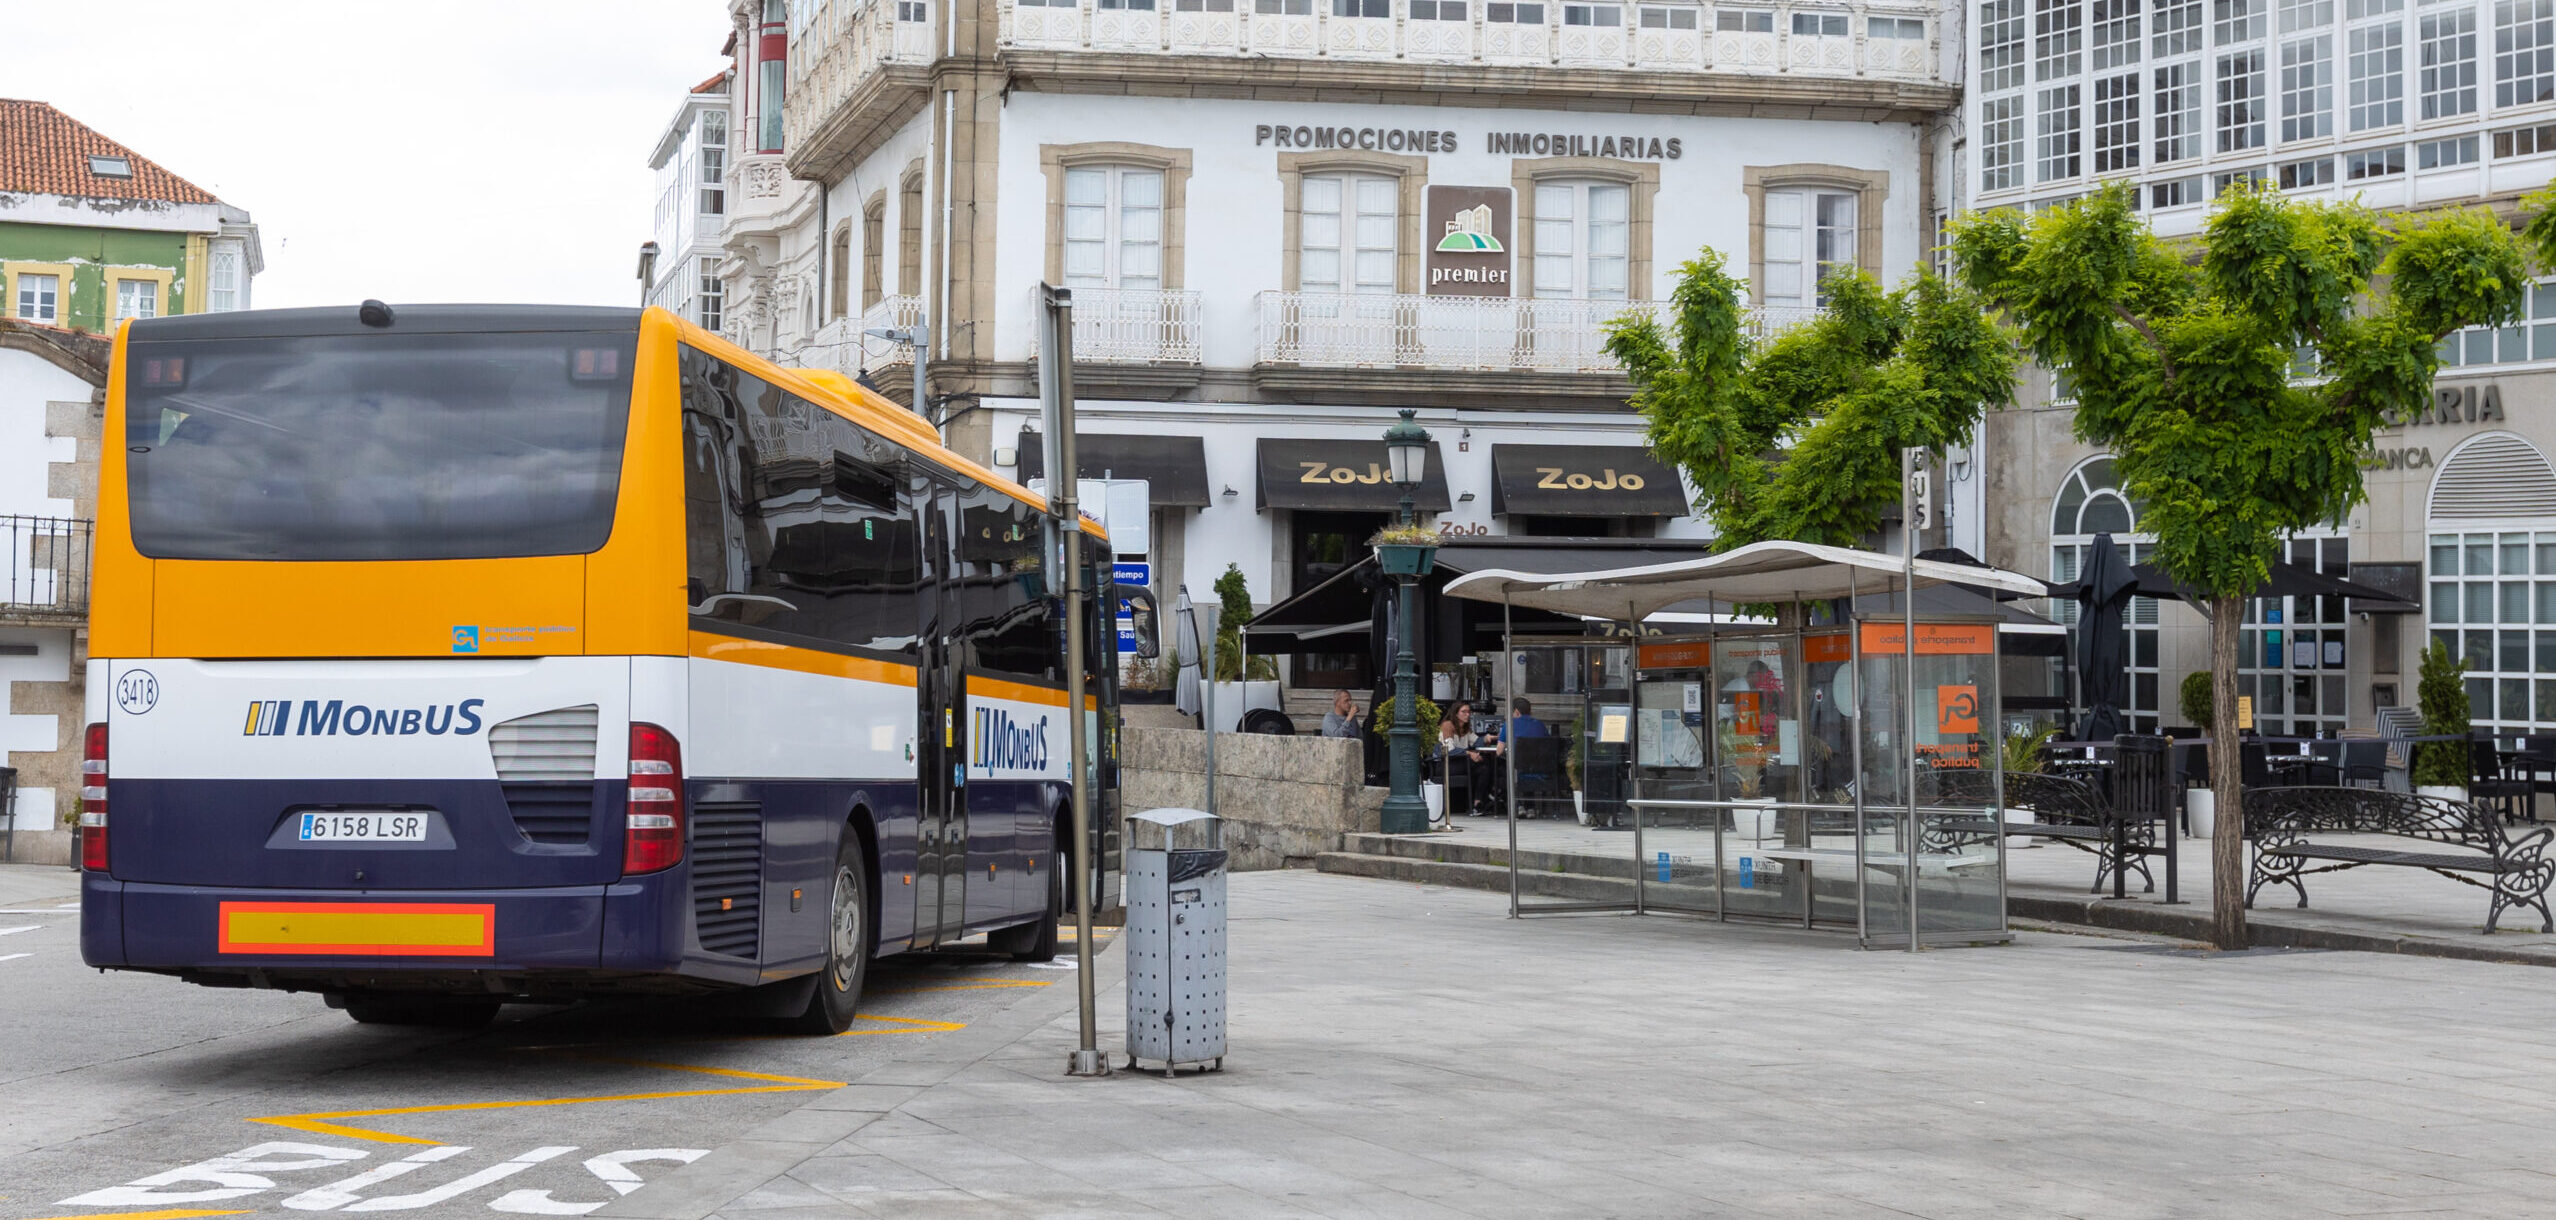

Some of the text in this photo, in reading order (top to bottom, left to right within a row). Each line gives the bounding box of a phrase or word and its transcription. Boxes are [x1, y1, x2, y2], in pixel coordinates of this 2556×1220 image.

[1255, 124, 1683, 160] PROMOCIONES INMOBILIARIAS
[1431, 266, 1508, 286] premier
[1536, 467, 1645, 491] ZoJo
[1440, 521, 1488, 536] ZoJo
[121, 678, 154, 705] 3418
[314, 817, 369, 837] 6158
[377, 817, 418, 837] LSR
[54, 1141, 713, 1216] BUS
